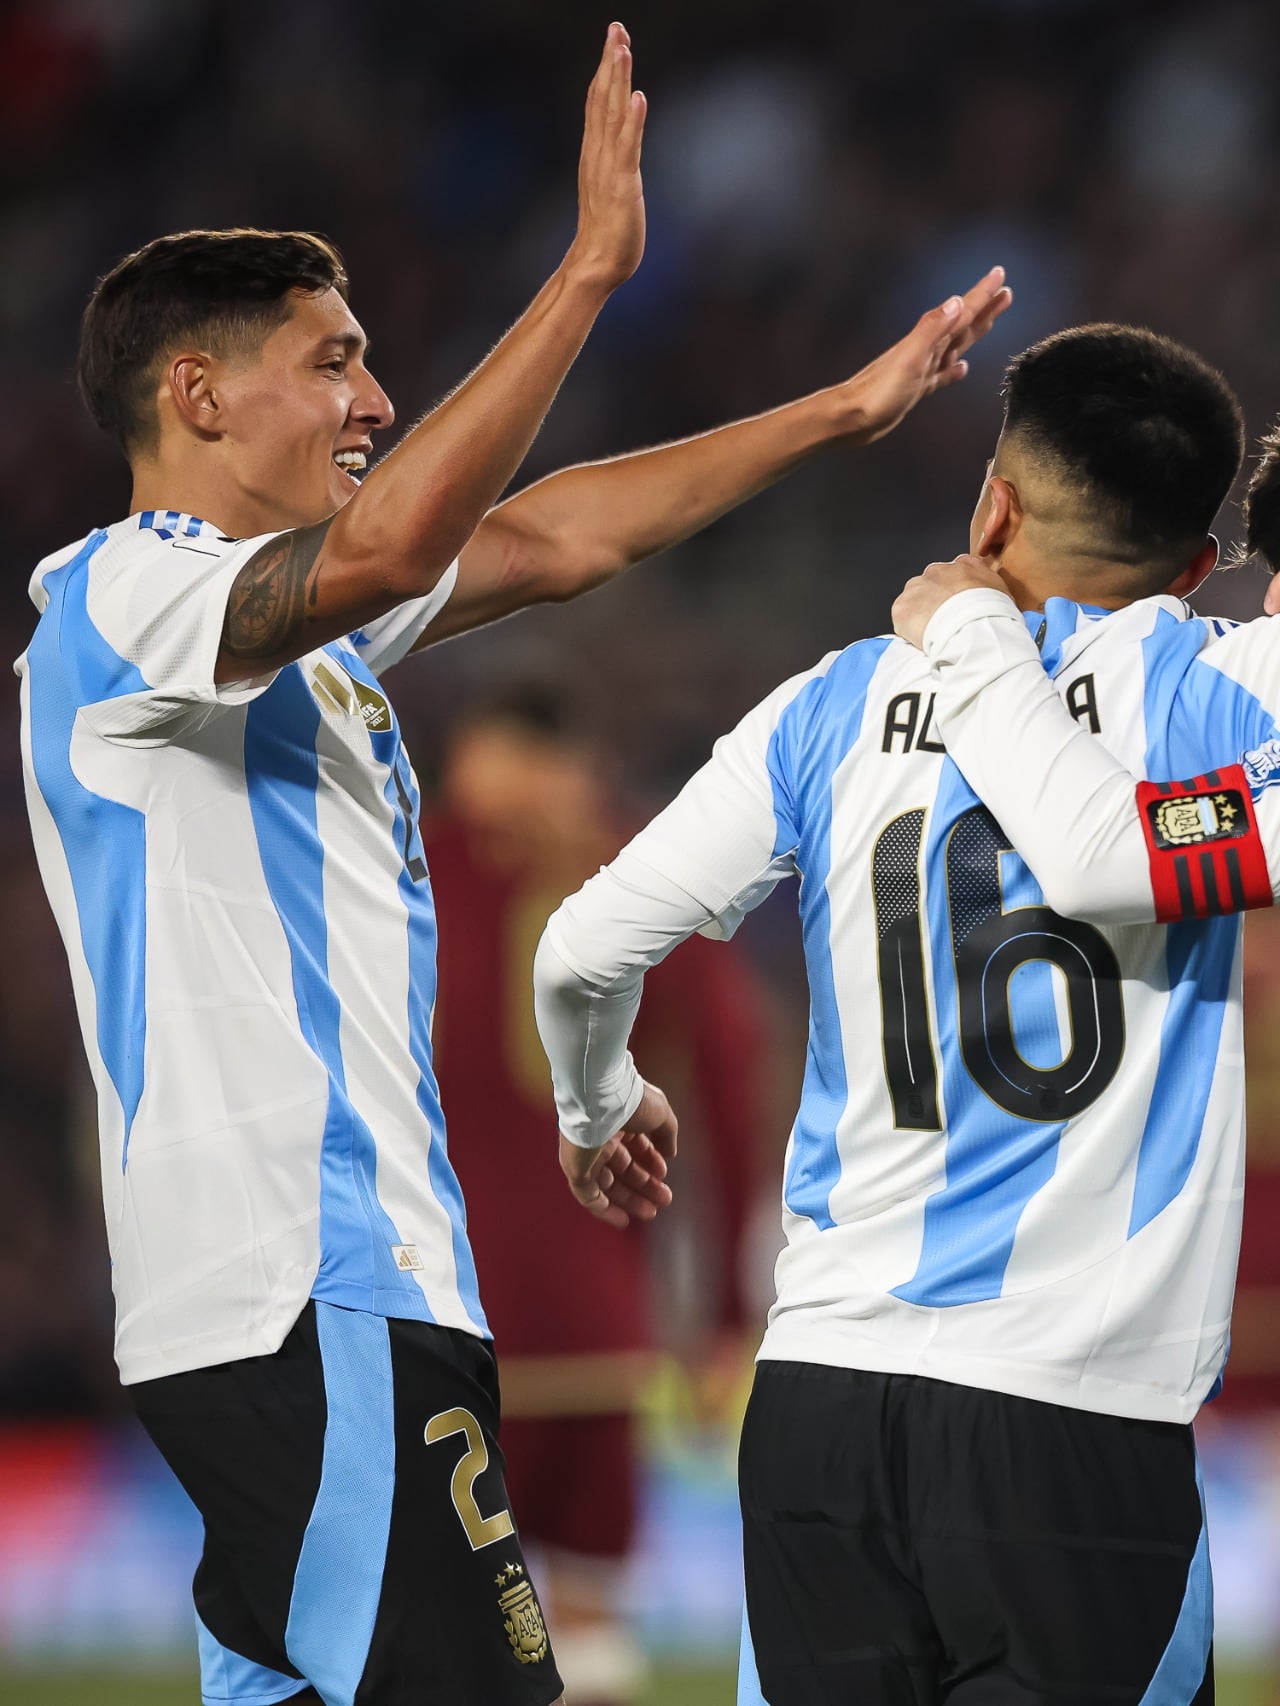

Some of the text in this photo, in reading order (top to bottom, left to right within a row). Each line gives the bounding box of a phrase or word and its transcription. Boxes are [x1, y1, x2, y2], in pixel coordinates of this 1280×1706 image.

[881, 673, 1102, 754] ALA
[871, 804, 1126, 1132] 16
[424, 1407, 515, 1551] 2
[517, 1603, 539, 1639] AFA
